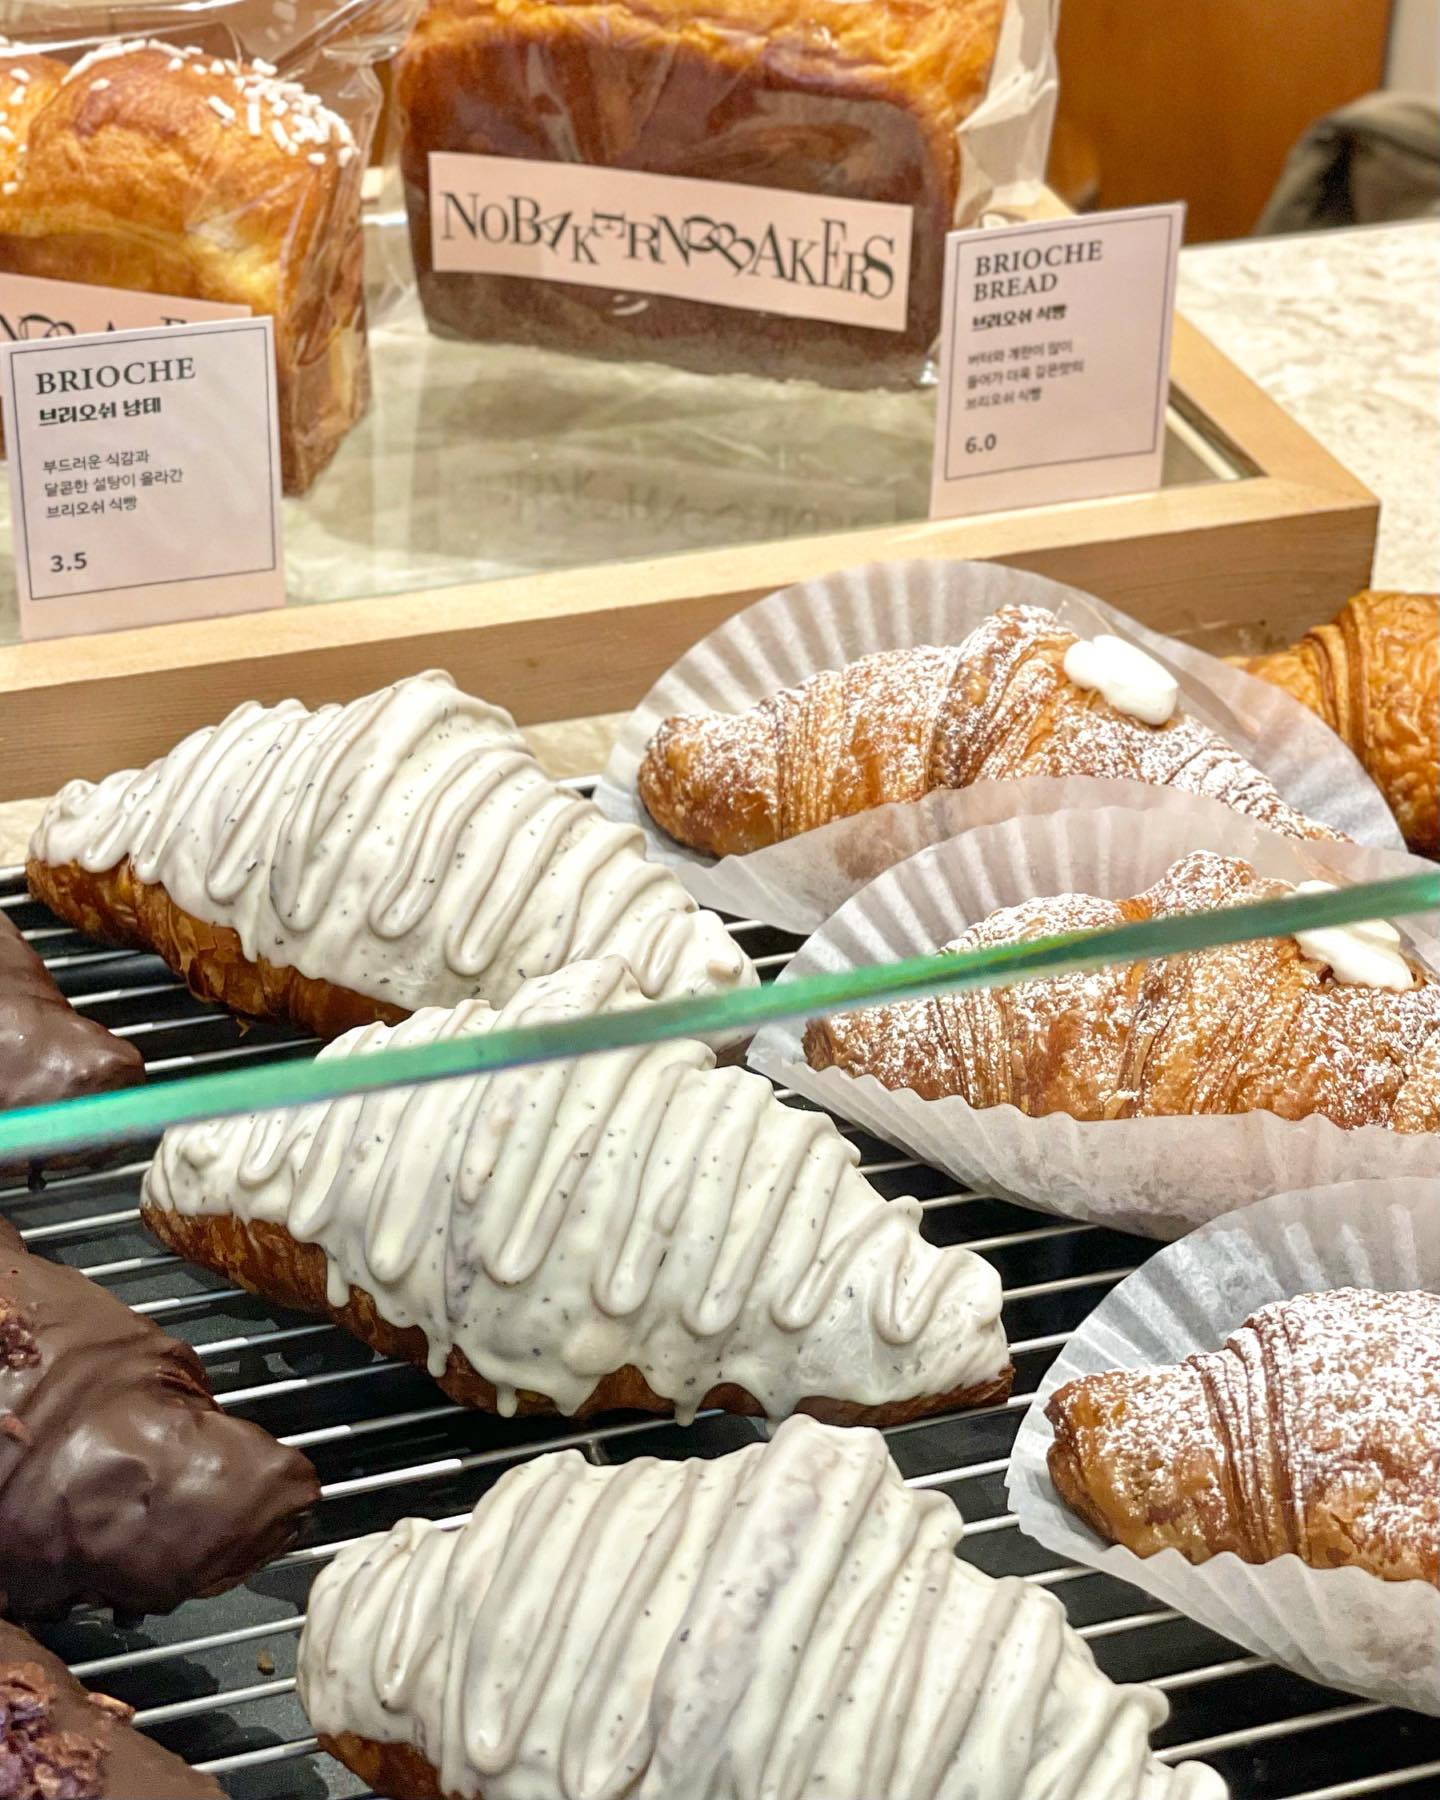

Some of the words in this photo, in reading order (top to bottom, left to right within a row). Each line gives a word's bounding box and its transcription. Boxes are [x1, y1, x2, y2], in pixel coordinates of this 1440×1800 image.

[974, 240, 1103, 277] BRIOCHE
[973, 273, 1057, 302] BREAD
[1036, 304, 1067, 321] 식빵
[36, 357, 196, 395] BRIOCHE
[39, 401, 117, 426] 브리오쉬
[964, 433, 997, 454] 6.0
[43, 454, 102, 475] 부드러운
[105, 449, 150, 467] 식감과
[44, 480, 88, 497] 달콤한
[93, 473, 136, 492] 설탕이
[139, 468, 183, 487] 올라간
[46, 499, 105, 518] 브리오쉬
[109, 496, 138, 511] 식빵
[50, 552, 88, 573] 3.5
